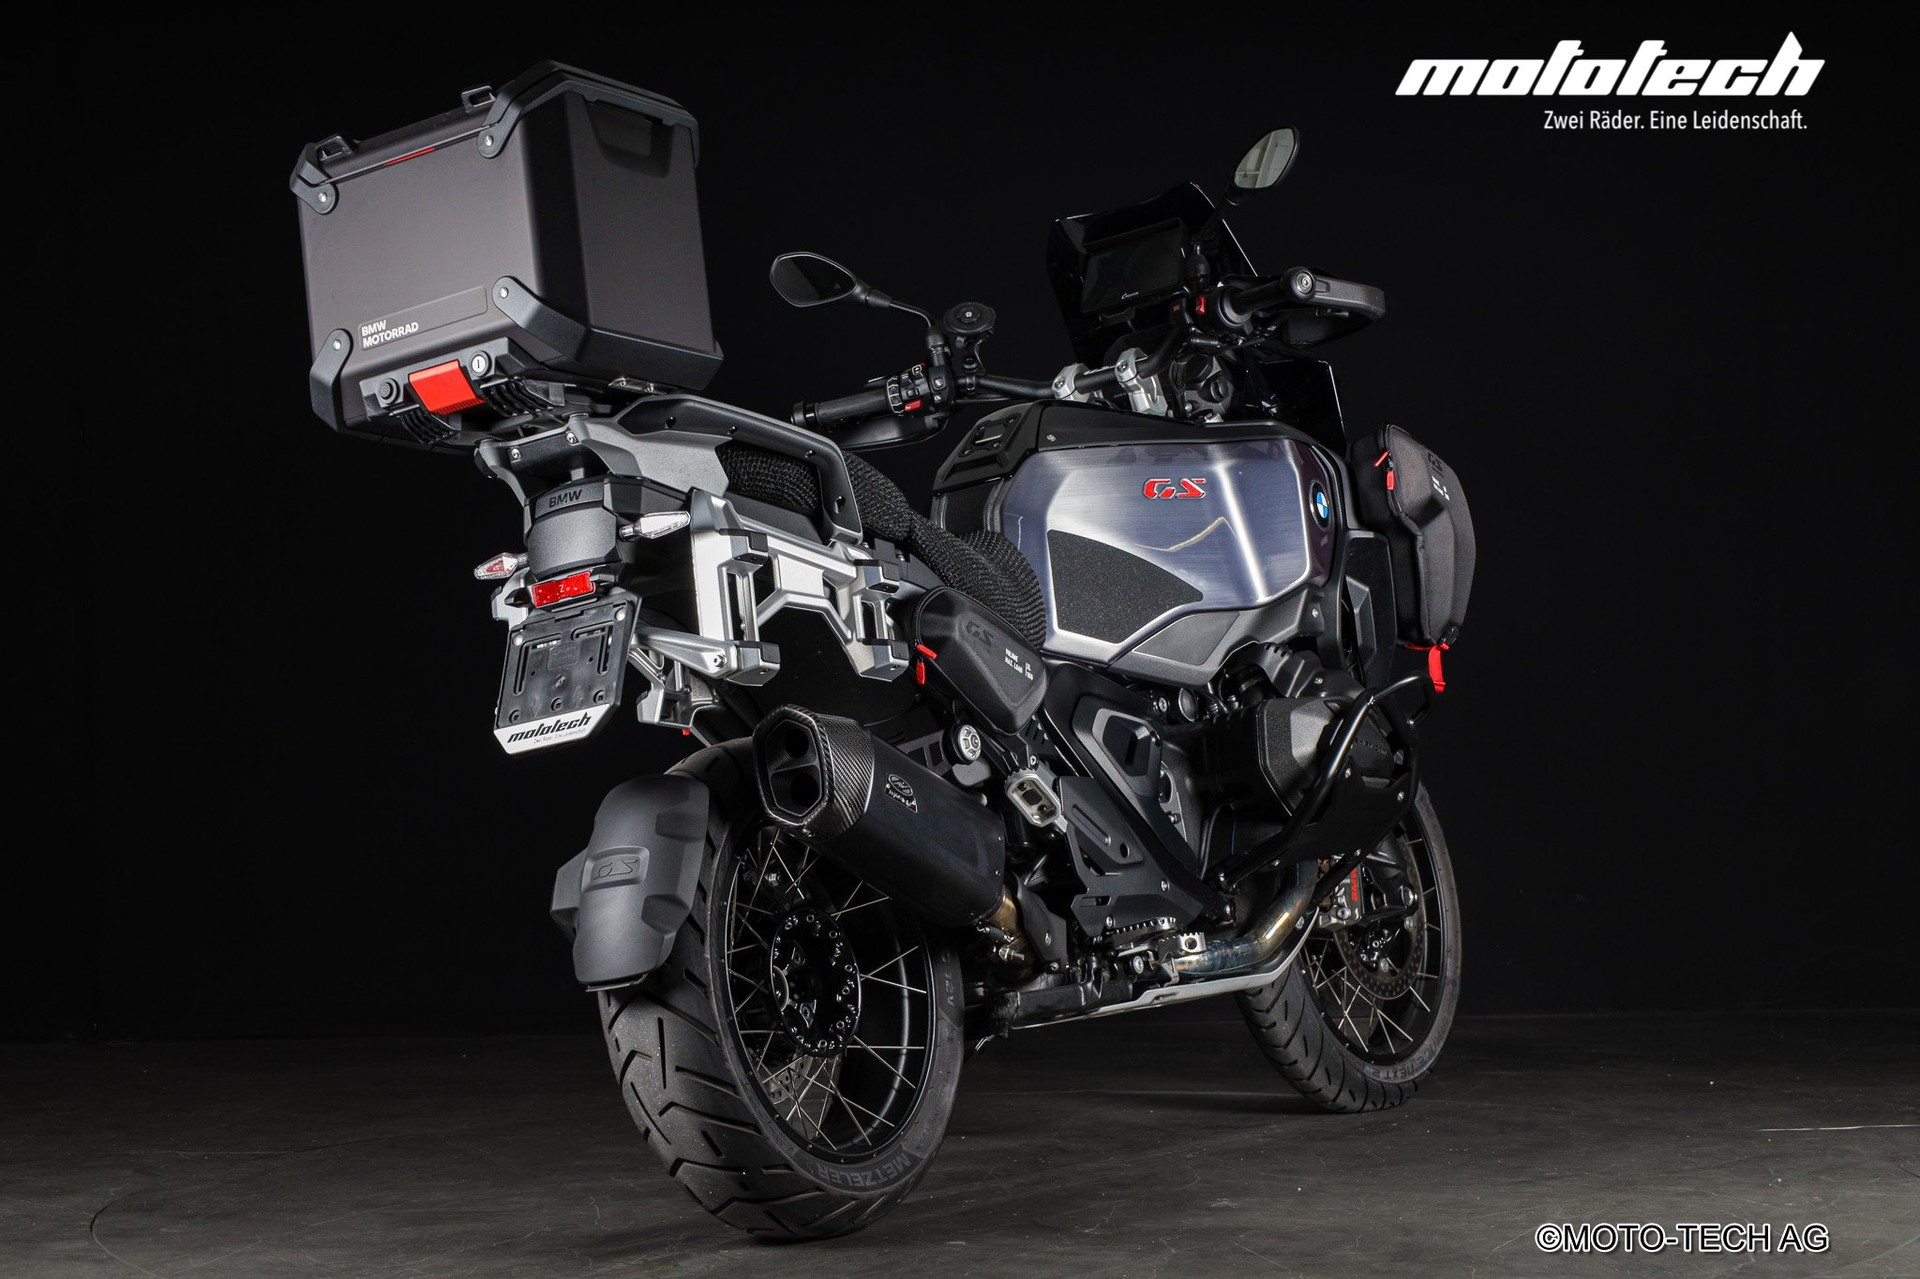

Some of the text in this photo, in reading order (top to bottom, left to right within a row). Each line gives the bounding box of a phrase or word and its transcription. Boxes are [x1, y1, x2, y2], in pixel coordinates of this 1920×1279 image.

[361, 319, 387, 337] BMW
[362, 322, 419, 348] MOTORRAD
[548, 489, 582, 508] BMW
[1143, 478, 1206, 499] GS
[507, 711, 592, 743] mototech
[816, 1152, 912, 1187] METZELER
